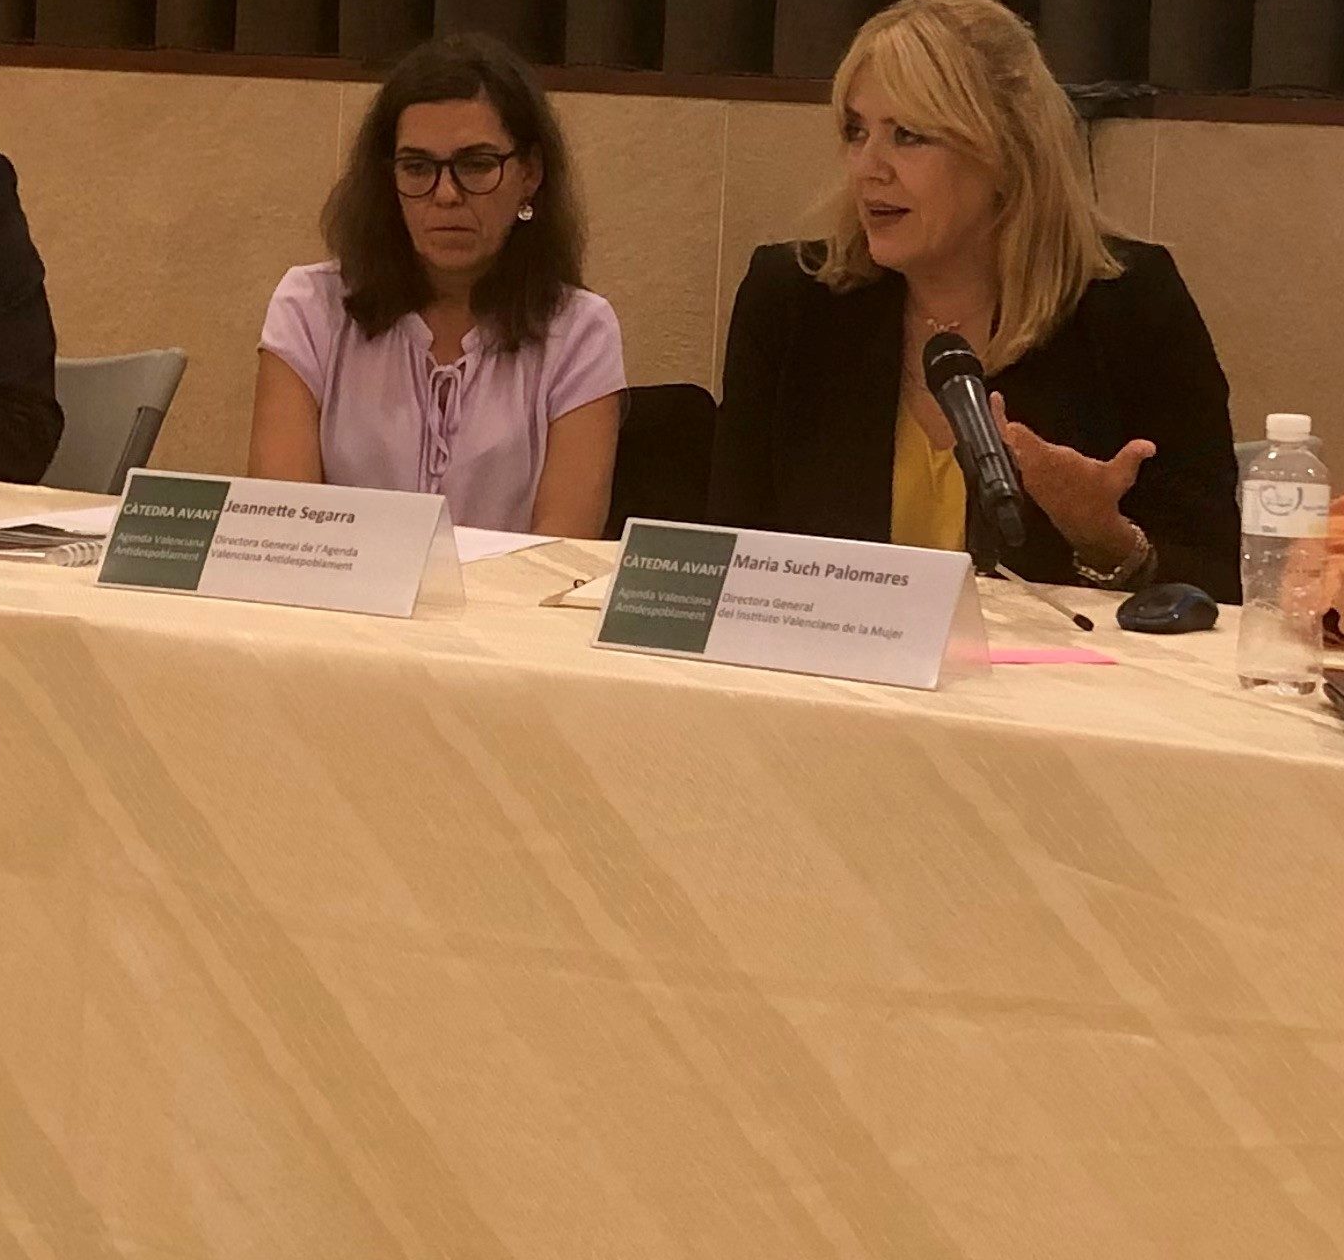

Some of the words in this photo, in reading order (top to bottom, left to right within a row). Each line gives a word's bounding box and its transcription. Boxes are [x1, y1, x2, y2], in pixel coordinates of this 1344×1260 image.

[123, 502, 175, 518] CÀTEDRA
[177, 508, 220, 521] AVANT
[224, 500, 296, 518] Jeannette
[299, 506, 356, 524] Segarra
[215, 535, 259, 548] Directora
[261, 539, 299, 551] General
[300, 542, 313, 553] de
[211, 550, 262, 562] Valenciana
[264, 554, 353, 571] Antidespoblament
[623, 554, 679, 572] CÀTEDRA
[681, 562, 726, 576] AVANT
[733, 554, 779, 572] Maria
[783, 559, 819, 577] Such
[824, 563, 909, 587] Palomares
[658, 591, 712, 606] Valenciana
[722, 593, 769, 607] Directora
[772, 598, 814, 612] General
[717, 607, 734, 619] del
[736, 610, 780, 624] Instituto
[782, 614, 840, 632] Valenciano
[842, 623, 855, 633] de
[858, 624, 868, 635] la
[870, 626, 904, 640] Mujer
